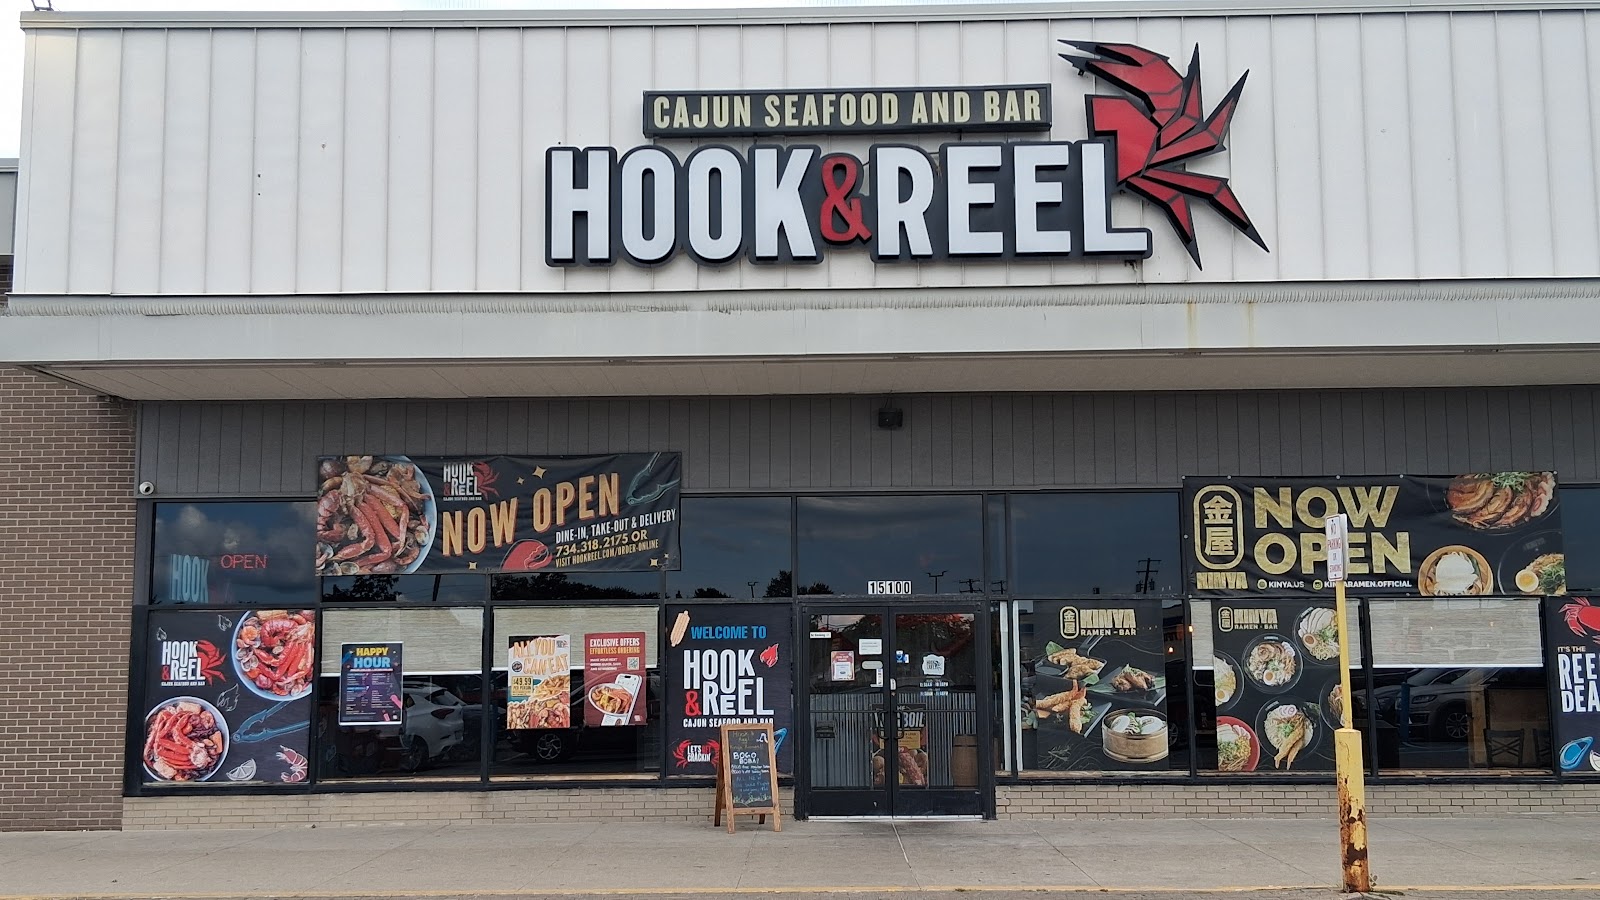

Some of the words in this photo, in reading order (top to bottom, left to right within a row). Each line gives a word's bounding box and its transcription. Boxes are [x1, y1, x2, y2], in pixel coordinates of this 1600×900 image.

[653, 95, 751, 128] CAJUN
[764, 92, 898, 127] SEAFOOD
[911, 91, 971, 124] AND
[984, 89, 1042, 122] BAR
[441, 496, 518, 557] NOW
[532, 472, 620, 534] OPEN
[1253, 485, 1400, 529] NOW
[555, 526, 589, 544] DINE-IN,
[591, 518, 629, 537] TAKE-OUT
[631, 516, 637, 528] &
[640, 509, 676, 528] DELIVERY
[1203, 495, 1235, 556] 金屋
[556, 533, 628, 557] 734.318.2175
[631, 529, 648, 542] OR
[221, 554, 268, 569] OPEN
[555, 557, 571, 568] VISIT
[1253, 531, 1412, 575] OPEN
[171, 553, 209, 604] HOOK
[869, 581, 910, 594] 15100
[1196, 571, 1248, 589] KINYA
[1080, 609, 1136, 628] KINYA
[1234, 609, 1278, 624] KINYA
[690, 626, 748, 639] WELCOME
[752, 625, 767, 638] TO
[356, 647, 389, 656] HAPPY
[535, 639, 555, 656] YOU
[589, 638, 619, 647] EXCLUSIVE
[620, 637, 640, 646] OFFERS
[162, 641, 198, 667] HOOK
[353, 657, 391, 668] HOUR
[523, 657, 546, 675] CAN
[548, 653, 569, 674] EAT
[683, 649, 755, 694] HOOK
[1558, 653, 1600, 690] REE
[683, 718, 707, 728] CAJUN
[733, 752, 757, 760] BOGO
